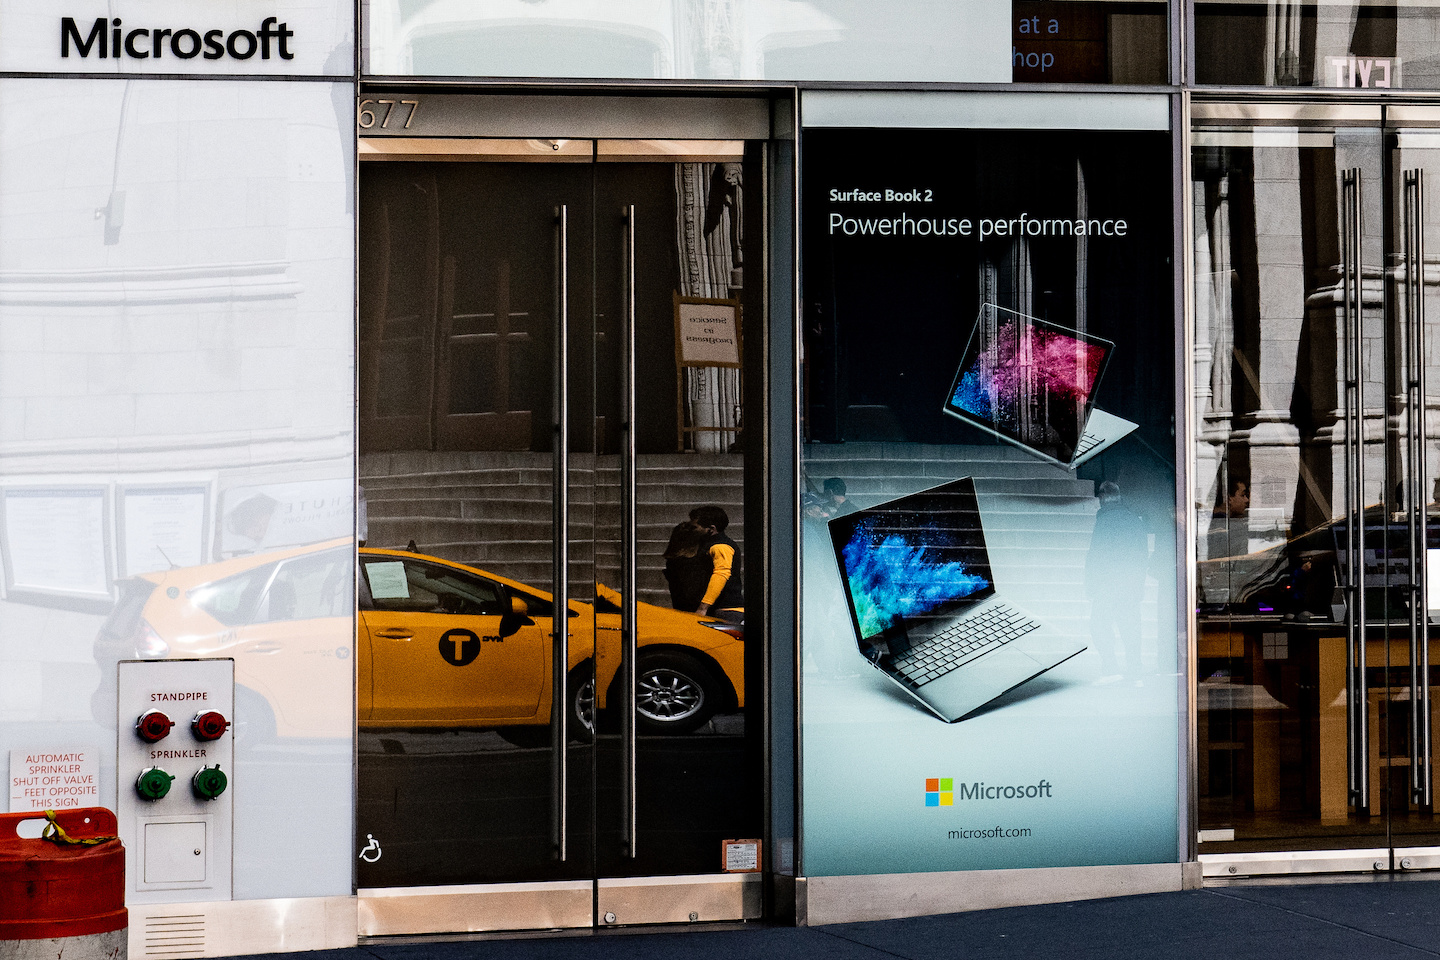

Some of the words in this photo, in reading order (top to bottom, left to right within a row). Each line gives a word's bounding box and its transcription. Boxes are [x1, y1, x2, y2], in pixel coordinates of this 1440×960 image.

[1019, 15, 1040, 34] at
[1047, 18, 1059, 34] a
[60, 16, 294, 60] Microsoft
[359, 99, 419, 129] 677
[829, 188, 880, 203] Surface
[885, 188, 920, 203] Book
[924, 189, 933, 202] 2
[828, 212, 972, 236] Powerhouse
[979, 212, 1128, 241] performance
[150, 692, 208, 702] STANDPIPE
[26, 753, 84, 764] AUTOMATIC
[150, 749, 207, 759] SPRINKLER
[29, 764, 81, 775] SPRINKLER
[13, 777, 40, 786] SHUT
[42, 776, 61, 785] OFF
[63, 775, 94, 784] VALVE
[24, 788, 46, 797] FEET
[49, 786, 97, 796] OPPOSITE
[960, 779, 1052, 801] Microsoft
[31, 798, 53, 808] THIS
[55, 798, 79, 807] SIGN
[948, 824, 1032, 839] microsoft.com
